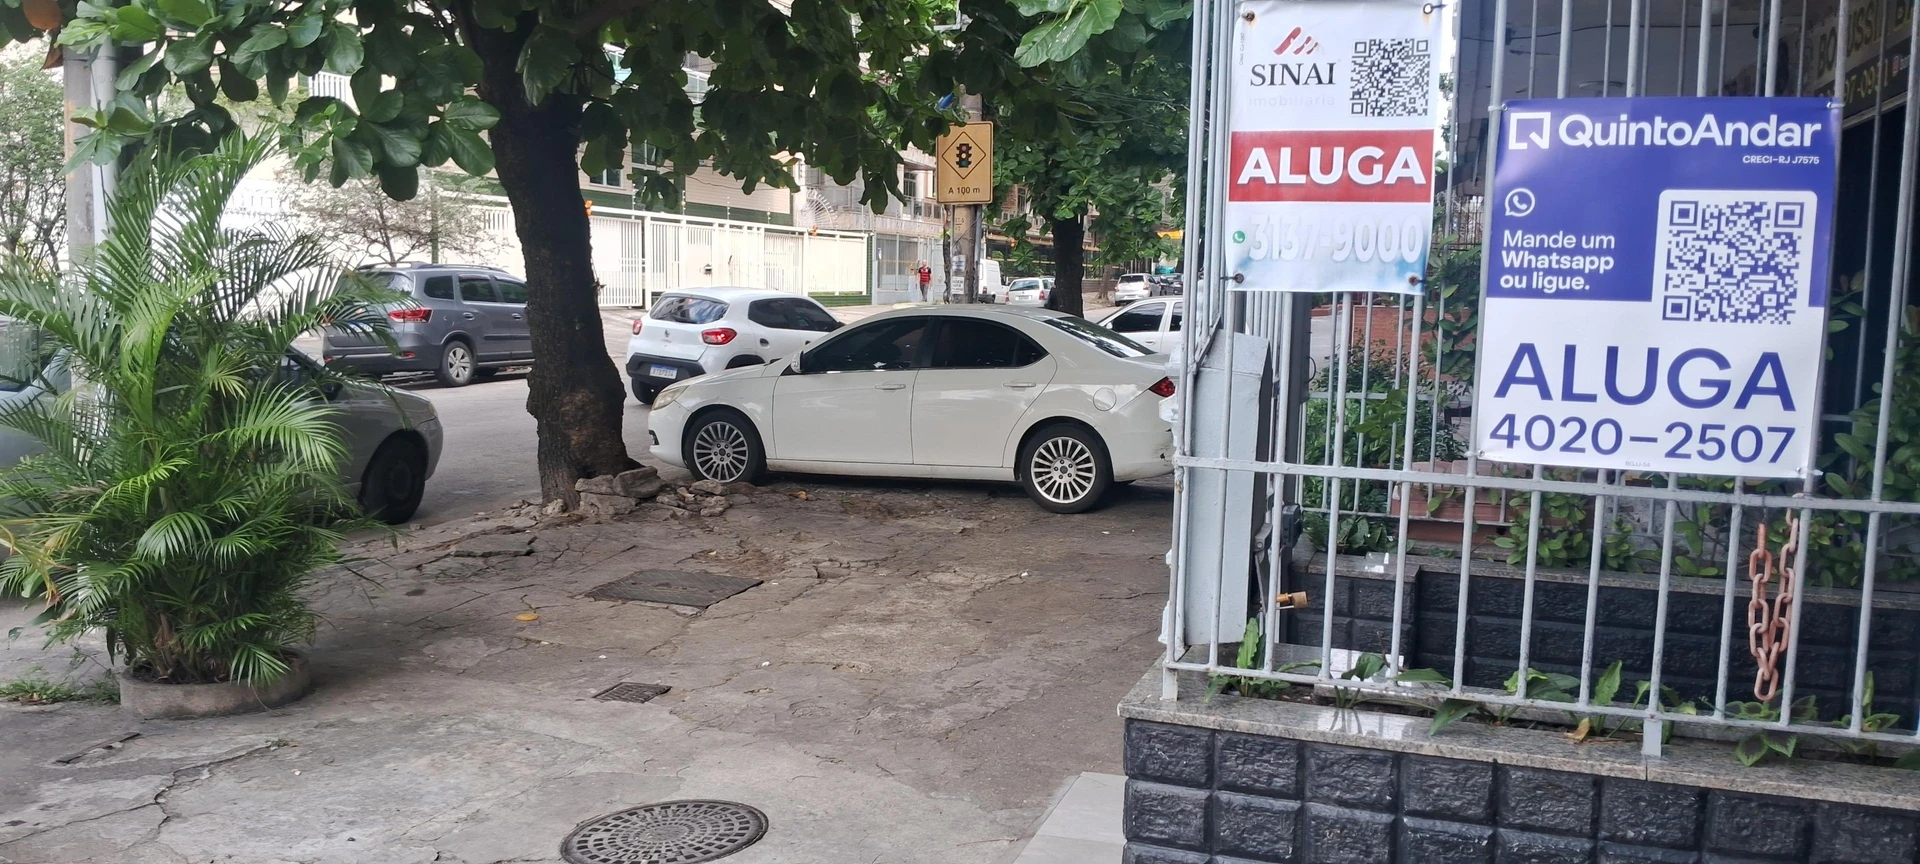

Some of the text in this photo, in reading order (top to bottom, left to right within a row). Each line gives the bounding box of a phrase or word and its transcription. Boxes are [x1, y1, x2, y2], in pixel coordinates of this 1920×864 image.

[1250, 62, 1336, 86] SINAI
[1558, 112, 1822, 149] QuintoAndar
[1237, 146, 1426, 185] ALUGA
[1742, 154, 1820, 165] CRECI-RJ J7575
[957, 186, 970, 194] 100
[1503, 230, 1615, 250] Mande um
[1501, 250, 1614, 274] Whatsapp
[1500, 271, 1591, 294] ou ligue.
[1493, 342, 1797, 412] ALUGA
[1489, 413, 1796, 464] 4020-2507
